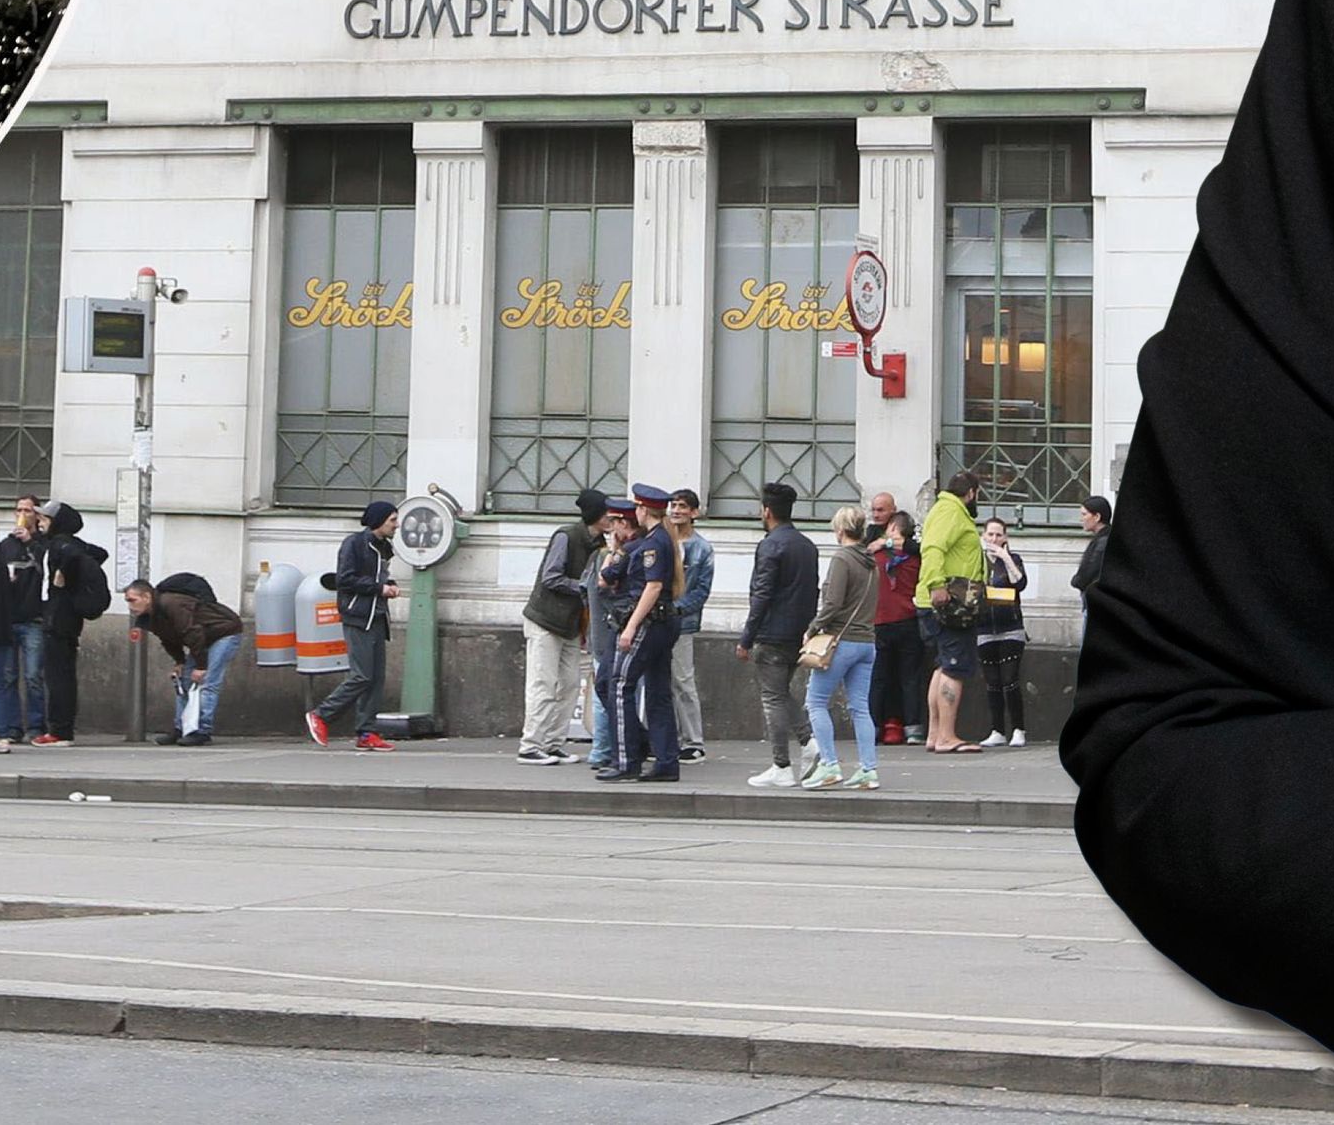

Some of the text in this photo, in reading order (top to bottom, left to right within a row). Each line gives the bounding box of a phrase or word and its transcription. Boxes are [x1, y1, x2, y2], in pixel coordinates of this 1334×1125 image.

[287, 277, 414, 329] Ströck
[499, 277, 632, 329] Ströck
[721, 277, 857, 332] Ströck
